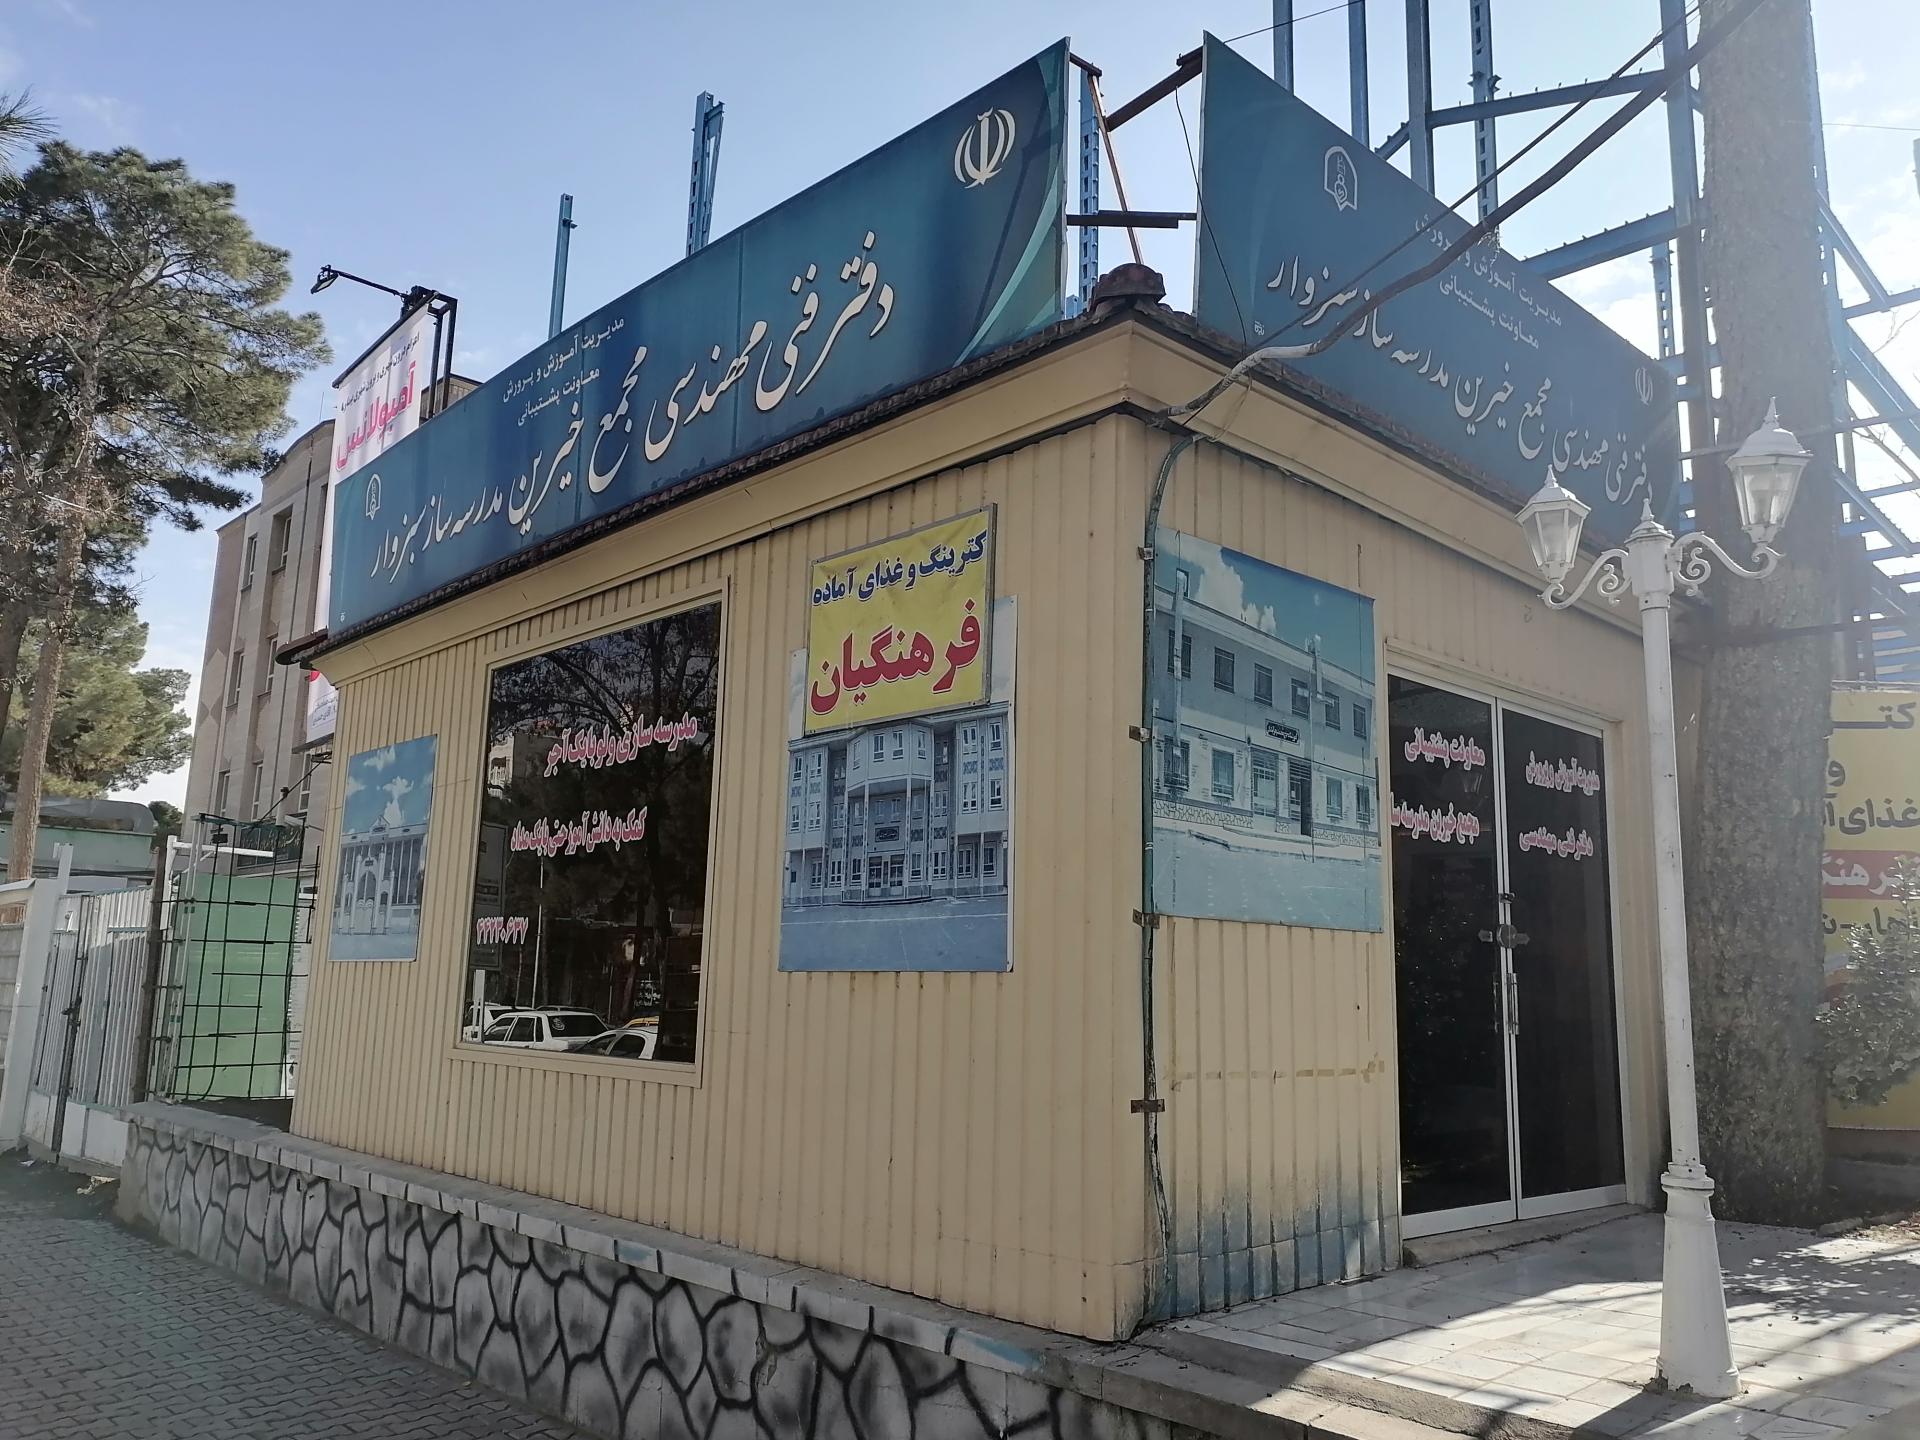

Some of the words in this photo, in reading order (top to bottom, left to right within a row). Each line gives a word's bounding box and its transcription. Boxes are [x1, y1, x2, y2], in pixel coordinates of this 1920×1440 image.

[1474, 255, 1516, 294] آموزش
[796, 231, 894, 395] دفتر
[1439, 274, 1495, 326] پشتیبانی
[1519, 288, 1562, 326] مدیریت
[581, 318, 624, 349] مدیریت
[755, 263, 819, 411] فنی
[1498, 311, 1539, 349] معاونت
[536, 367, 541, 382] و
[543, 334, 579, 378] آموزش
[1391, 349, 1449, 388] مدرسه
[503, 371, 534, 403] پرورش
[562, 368, 600, 395] معاونت
[644, 320, 768, 461] مهندسی
[1454, 361, 1514, 435] خیرین
[336, 360, 416, 470] آمبولانس
[517, 387, 560, 426] پشتیبانی
[588, 346, 647, 493] مجمع
[1518, 377, 1551, 460] مجمع
[508, 401, 584, 535] خیرین
[1552, 427, 1609, 473] مهندسی
[1605, 431, 1628, 501] فنی
[421, 493, 453, 551] ساز
[449, 485, 503, 538] مدرسه
[370, 504, 427, 584] سبزوار
[919, 529, 987, 576] کترینگ
[812, 566, 857, 606] آماده
[858, 556, 904, 601] غذای
[905, 561, 915, 590] و
[809, 597, 981, 715] فرهنگیان
[616, 713, 653, 764] سازی
[654, 711, 697, 752] مدرسه
[1404, 727, 1450, 769] پشتیبانی
[543, 727, 572, 778] آجر
[1450, 735, 1485, 771] معاونت
[1828, 760, 1846, 787] و
[622, 806, 648, 842] کمک
[1401, 801, 1430, 839] مدرسه
[1456, 812, 1480, 844] مجمع
[1839, 798, 1920, 835] غذای
[1519, 826, 1557, 854] مهندسی
[1557, 827, 1575, 858] فنی
[1574, 829, 1594, 861] دفتر
